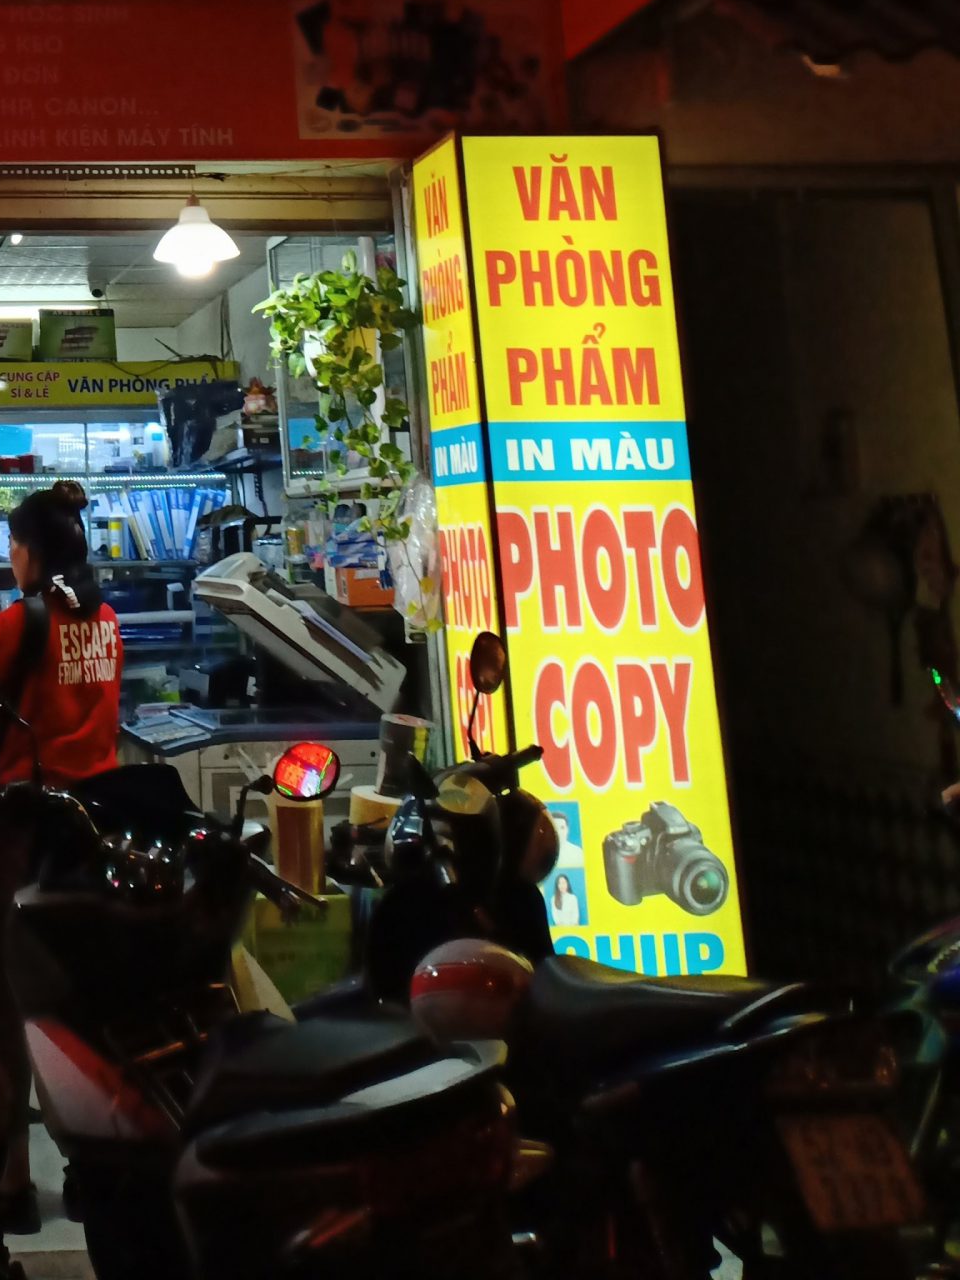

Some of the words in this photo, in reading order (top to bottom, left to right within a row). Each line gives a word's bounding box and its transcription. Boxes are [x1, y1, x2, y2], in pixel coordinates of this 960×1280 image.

[55, 121, 109, 152] KIỆN
[116, 122, 172, 149] MÁY
[177, 121, 234, 147] TÍNH
[424, 173, 450, 239] VĂN
[511, 152, 619, 222] VĂN
[422, 249, 465, 324] PHÒNG
[483, 234, 663, 308] PHÒNG
[23, 389, 34, 399] &
[67, 376, 104, 394] VĂN
[108, 373, 171, 395] PHÒNG
[430, 330, 471, 416] PHẨM
[505, 321, 662, 407] PHẨM
[434, 446, 449, 477] IN
[449, 435, 478, 475] MÀU
[505, 437, 555, 471] IN
[569, 430, 676, 471] MÀU
[496, 505, 707, 631] PHOTO
[58, 620, 118, 662] ESCAPE
[58, 660, 83, 685] FROM
[535, 658, 694, 790] COPY
